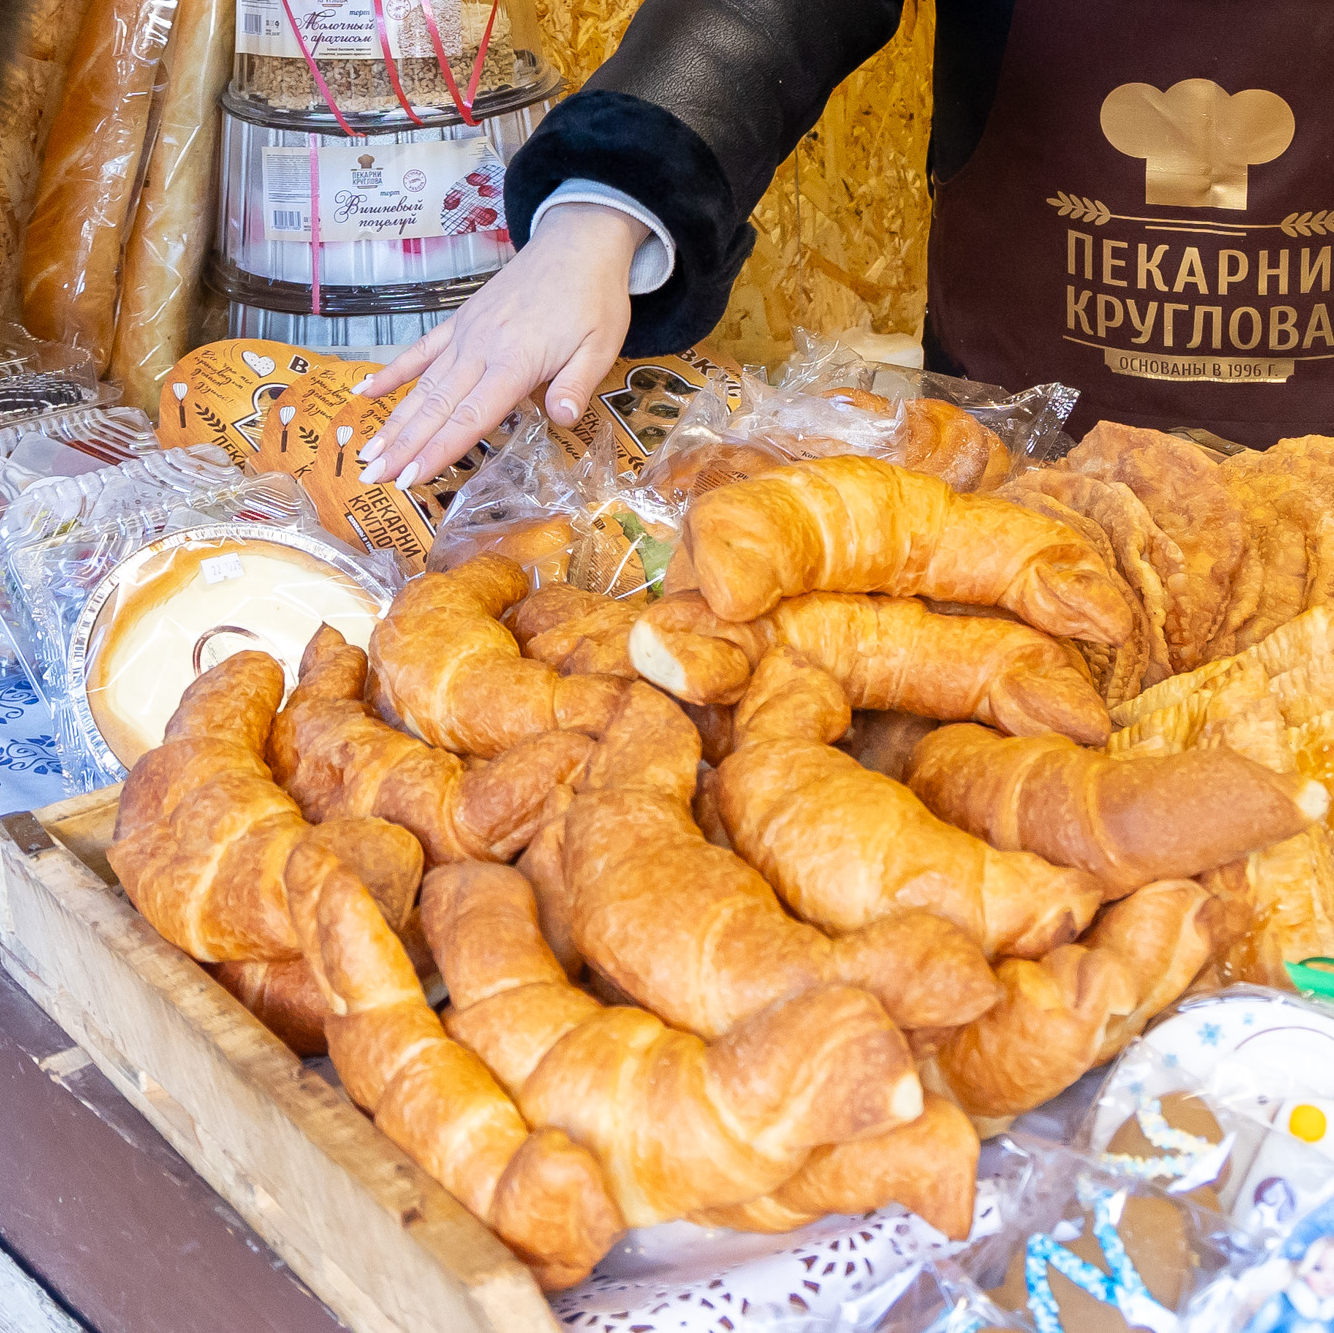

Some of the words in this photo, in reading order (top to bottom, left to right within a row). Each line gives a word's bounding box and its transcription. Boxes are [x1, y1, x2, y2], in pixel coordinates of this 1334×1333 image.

[295, 9, 375, 30] Молочный
[349, 9, 370, 17] торт
[310, 32, 373, 57] арахисом
[352, 178, 383, 186] КРУГЛОВА
[334, 190, 423, 223] Вишневый
[359, 214, 417, 235] поцелуй
[1067, 229, 1331, 295] ПЕКАРНИ
[1067, 285, 1334, 350] КРУГЛОВА
[1119, 356, 1206, 377] ОСНОВАНЫ
[1213, 367, 1221, 377] В
[1228, 363, 1262, 377] 1996
[1268, 363, 1278, 377] Г.
[365, 487, 421, 558] ПЕКАРНИ
